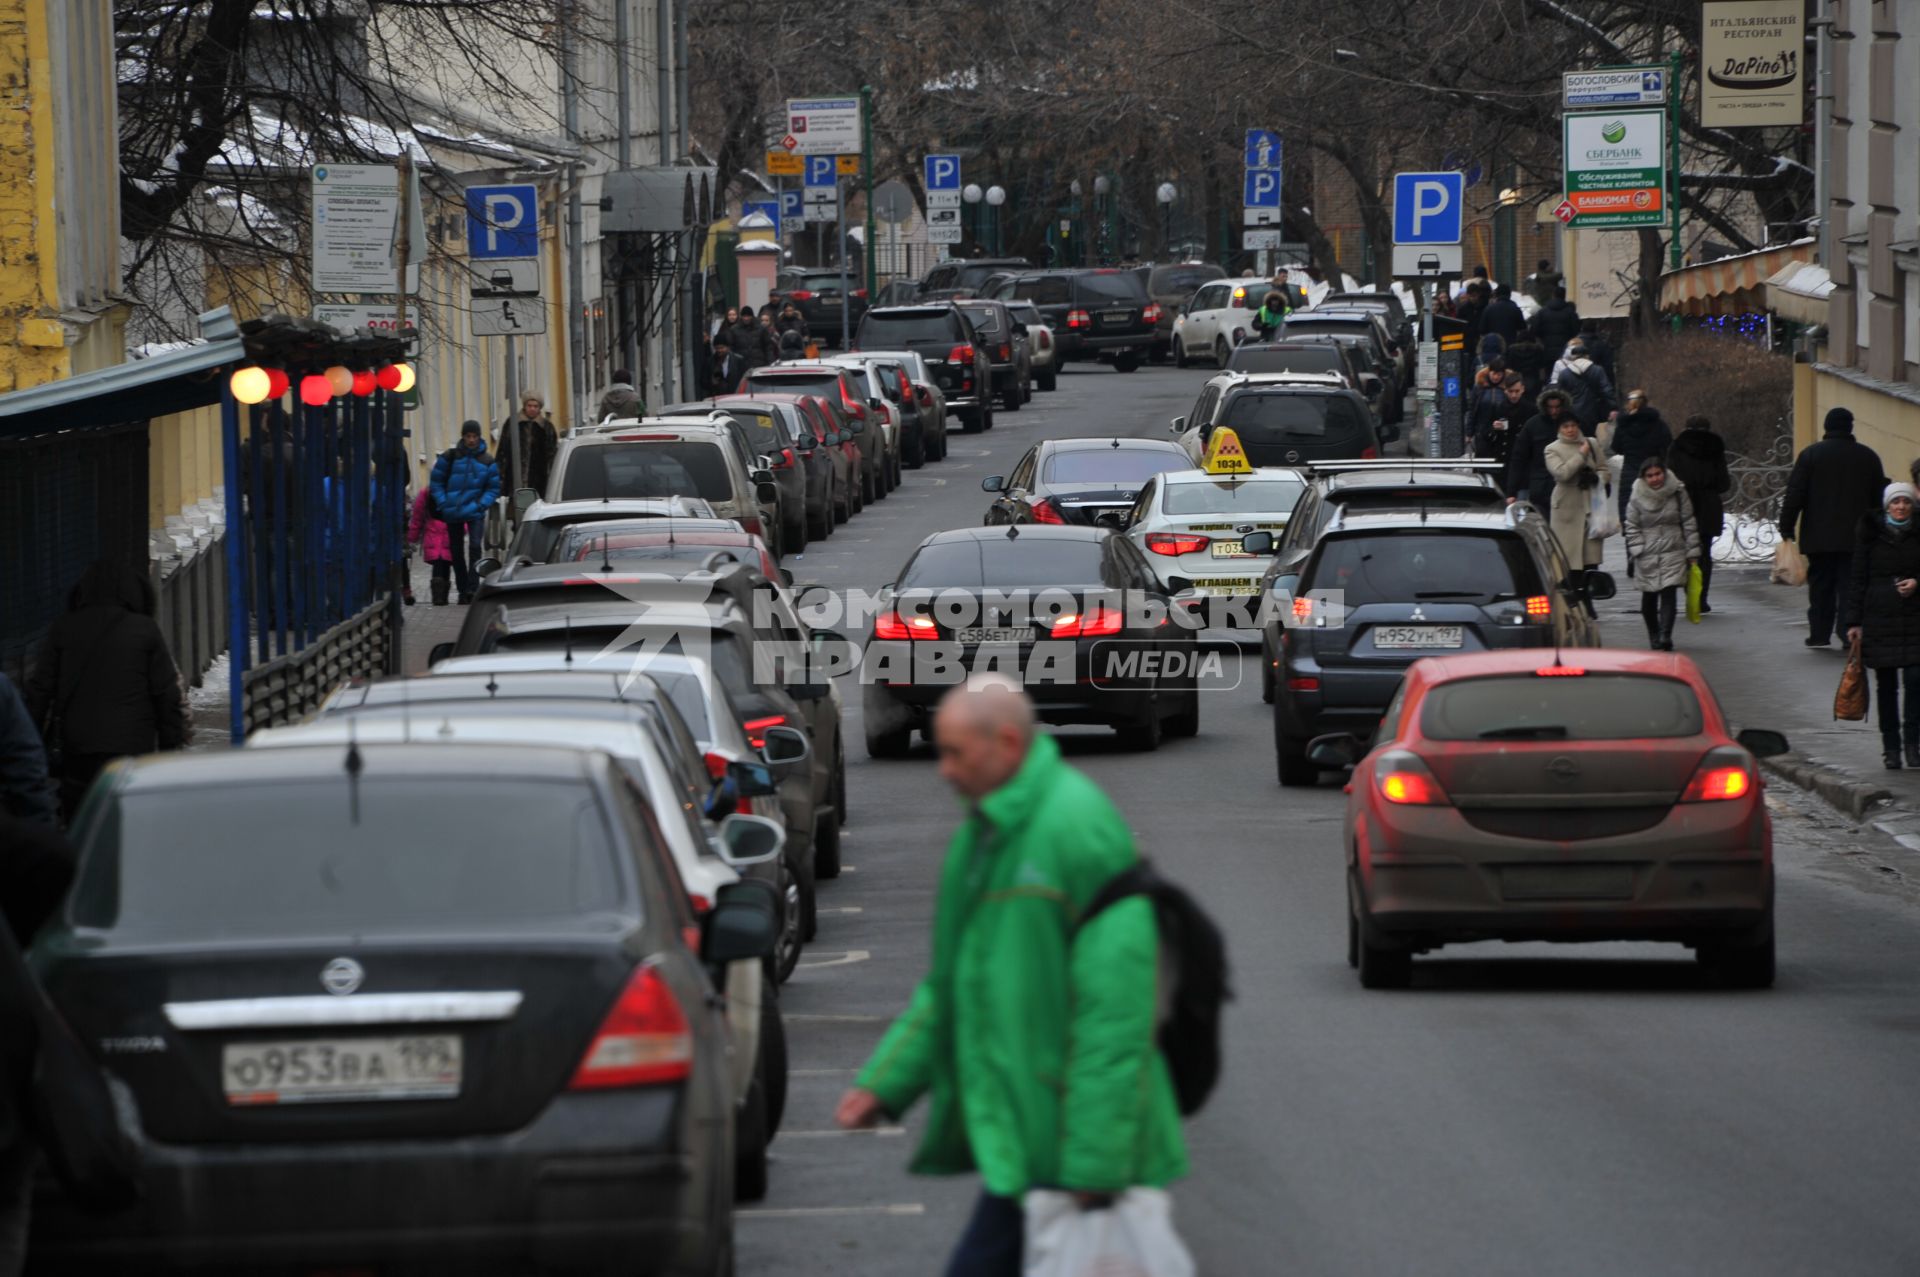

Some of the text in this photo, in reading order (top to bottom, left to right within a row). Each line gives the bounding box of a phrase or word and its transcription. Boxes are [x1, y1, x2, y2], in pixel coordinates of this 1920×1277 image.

[1710, 16, 1796, 27] ИТАЛЬЯНСКИЙ
[1724, 29, 1782, 39] РЕСТОРАН
[1723, 56, 1780, 75] DaPino
[1568, 73, 1640, 86] БОГОСЛОВСКИЙ
[1586, 148, 1642, 159] СБЕРБАНК
[935, 159, 954, 187] P
[1578, 172, 1643, 182] Обслуживание
[1255, 173, 1274, 203] P
[1615, 180, 1656, 188] клиентов
[1578, 194, 1631, 205] БАНКОМАТ
[1413, 181, 1449, 236] P
[485, 194, 524, 251] P
[1216, 460, 1243, 469] 1034
[958, 628, 1009, 642] С586ЕТ
[1379, 628, 1434, 642] Н952УН
[236, 1046, 387, 1087] О953ВА
